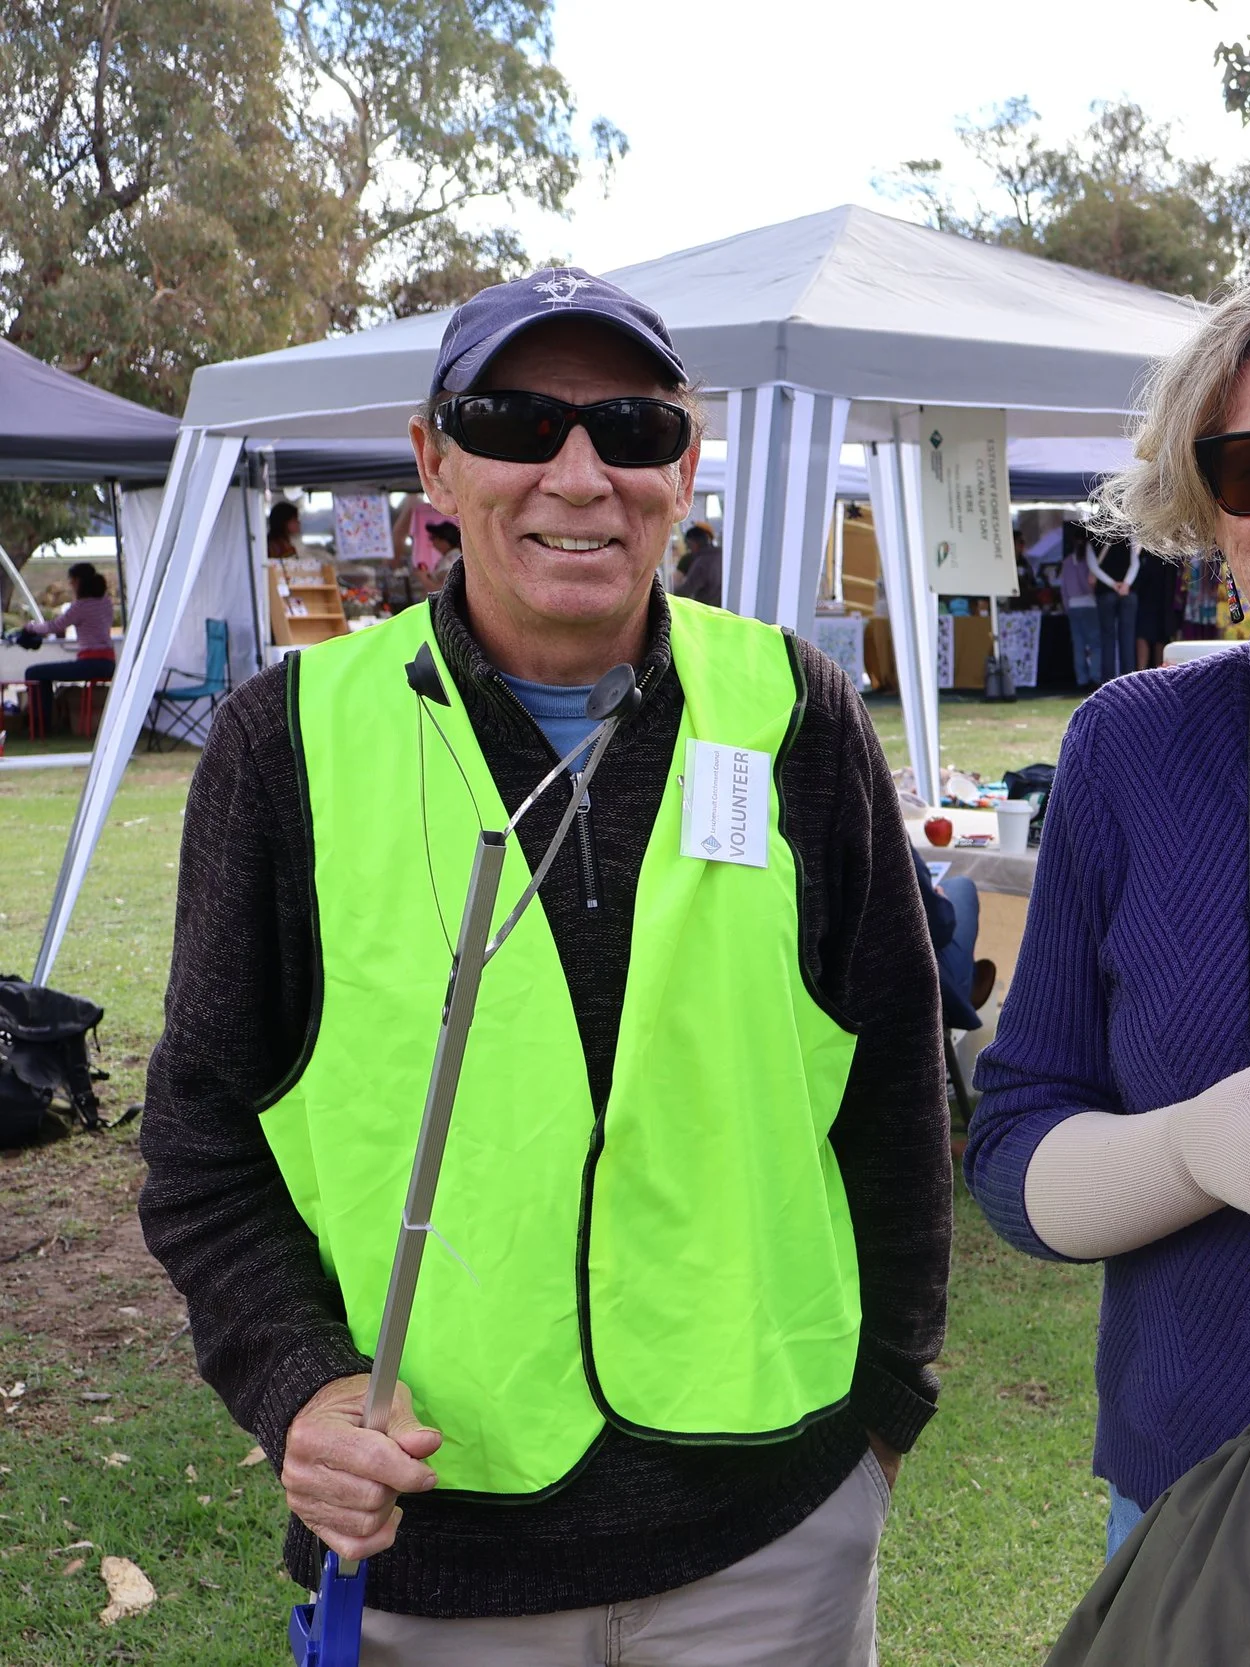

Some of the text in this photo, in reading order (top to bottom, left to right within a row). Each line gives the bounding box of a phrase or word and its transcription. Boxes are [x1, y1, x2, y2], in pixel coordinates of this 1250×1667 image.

[989, 490, 1003, 560] FORESHORE
[713, 750, 721, 770] Council
[711, 770, 721, 801] Catchment
[729, 751, 749, 857] VOLUNTEER
